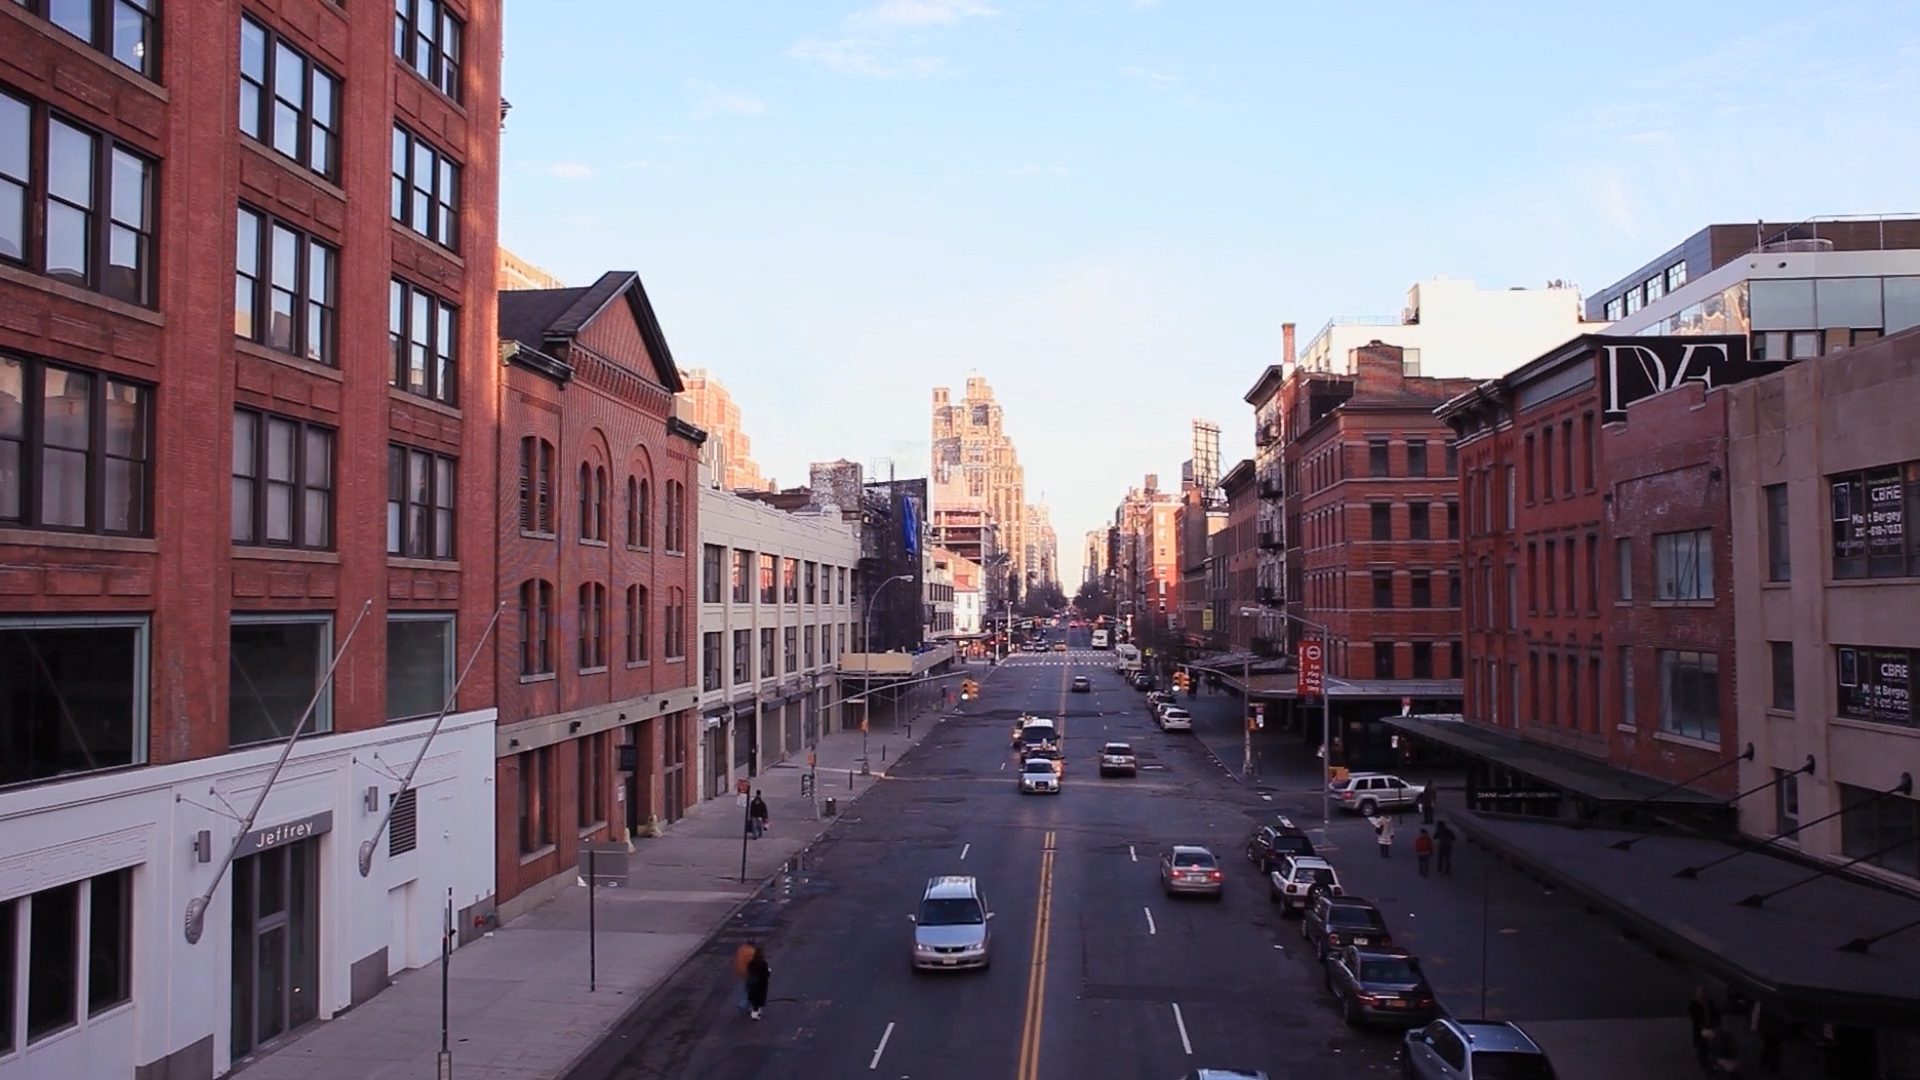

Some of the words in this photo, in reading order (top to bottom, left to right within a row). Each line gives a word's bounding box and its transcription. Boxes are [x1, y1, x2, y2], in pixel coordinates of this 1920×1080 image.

[1871, 485, 1901, 502] CBRE
[1852, 513, 1872, 524] Mat
[1881, 663, 1909, 678] CBRE
[255, 821, 313, 848] Jeffrey
